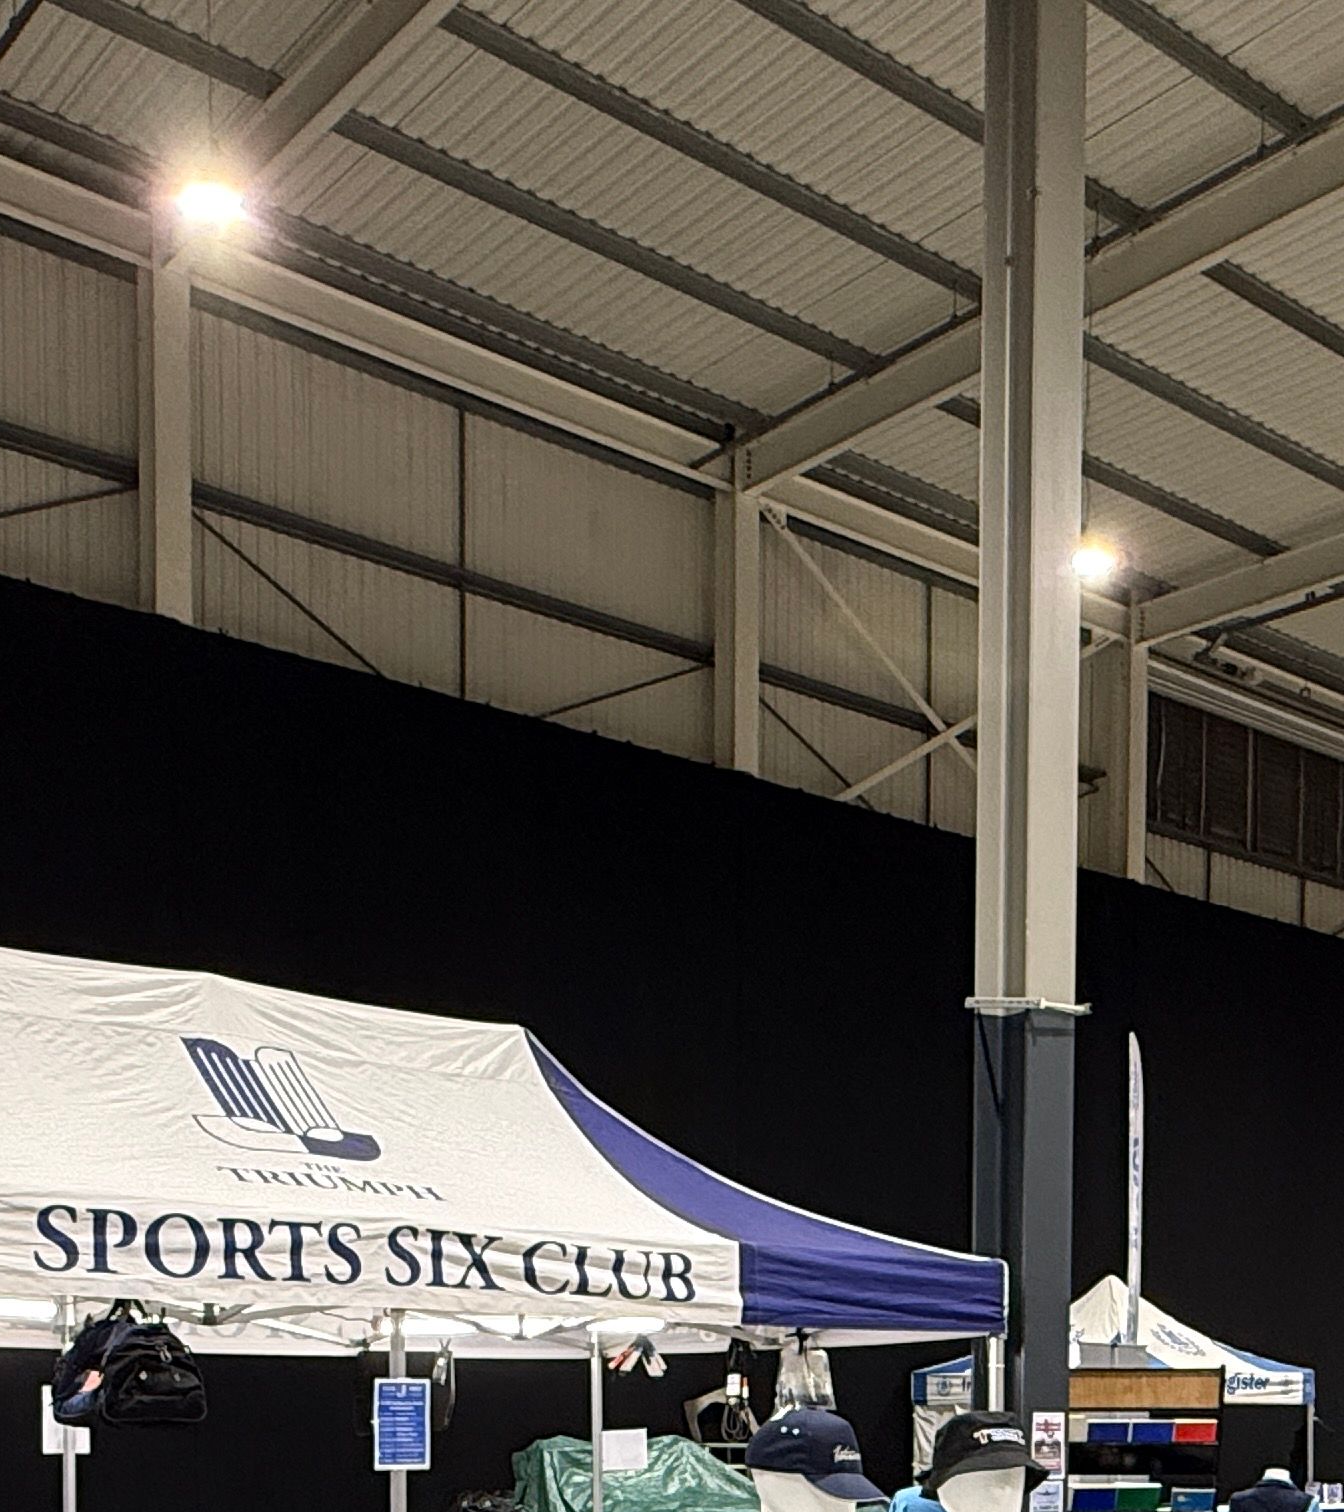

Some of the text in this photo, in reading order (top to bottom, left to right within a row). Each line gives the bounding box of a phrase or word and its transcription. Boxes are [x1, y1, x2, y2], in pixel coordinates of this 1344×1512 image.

[216, 1165, 448, 1201] TRIUMPH
[33, 1204, 697, 1302] SPORTS SIX CLUB
[1227, 1372, 1270, 1396] gister
